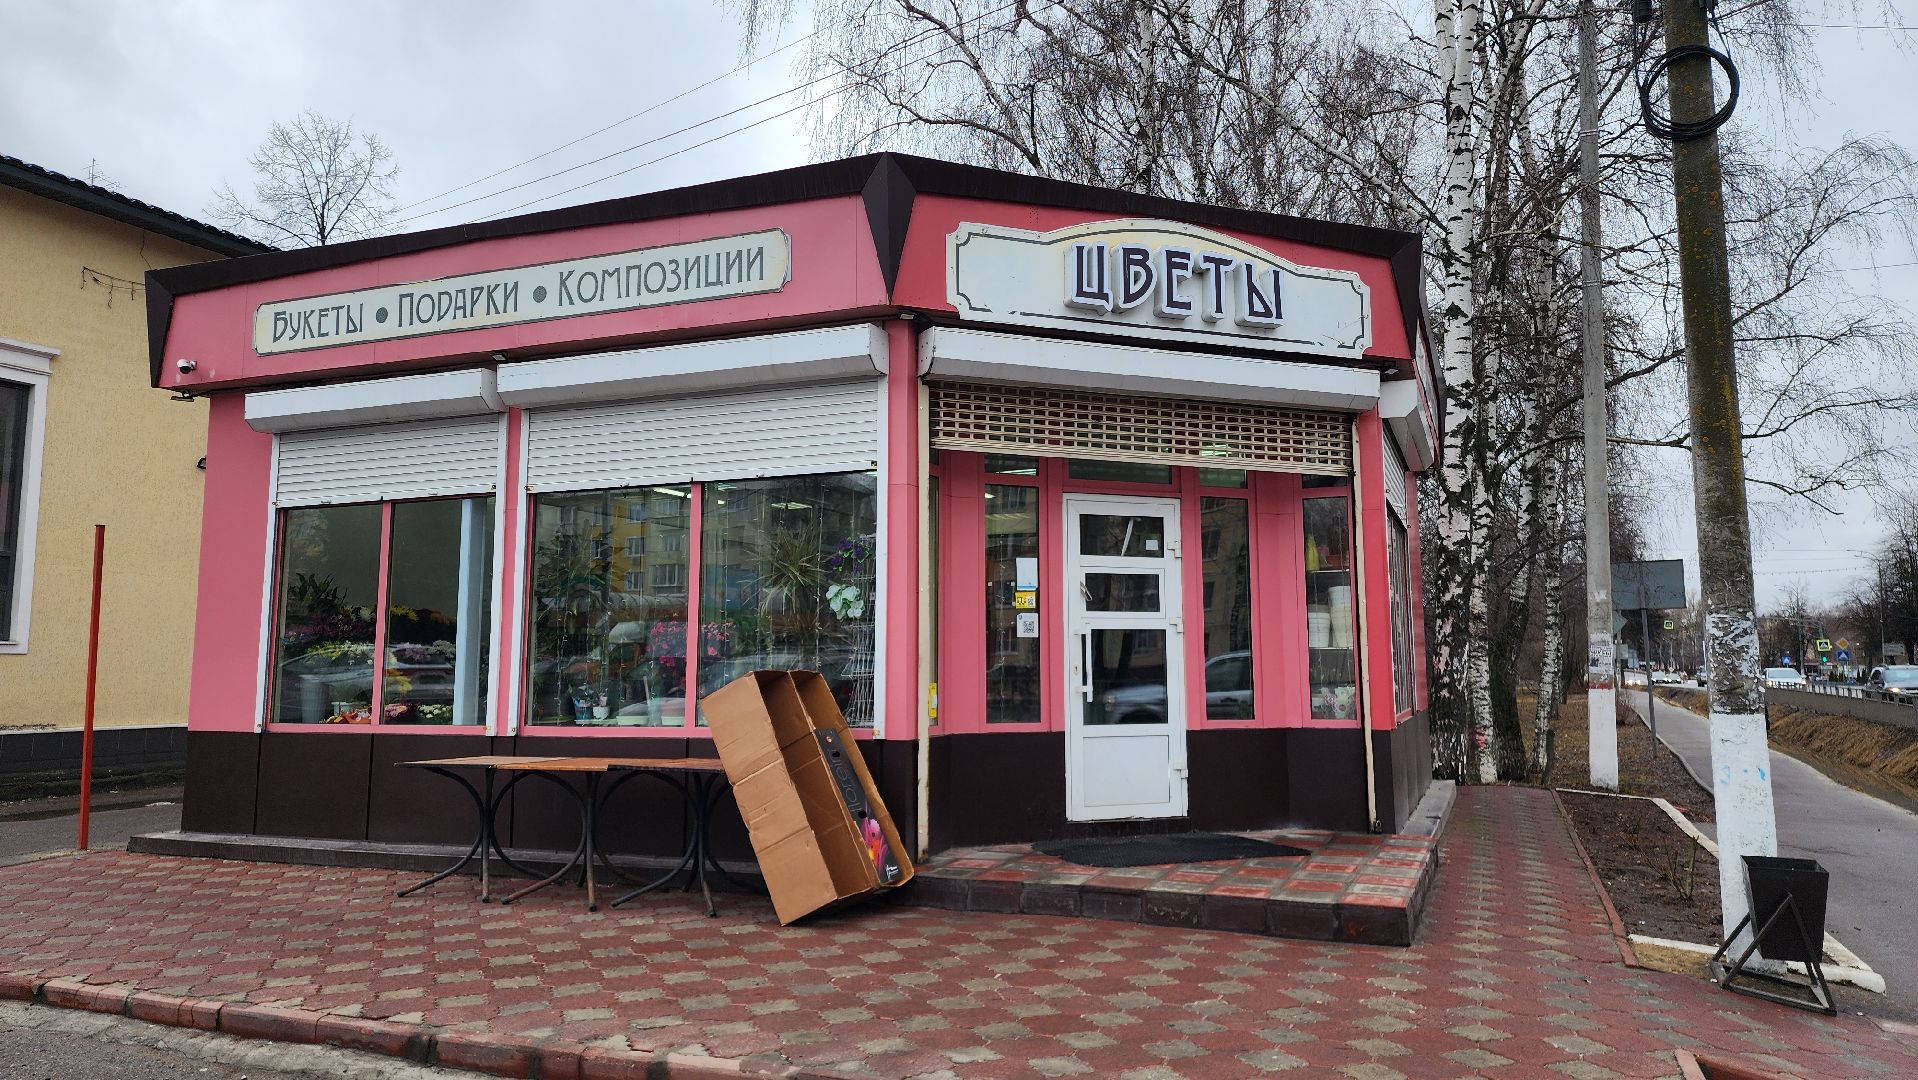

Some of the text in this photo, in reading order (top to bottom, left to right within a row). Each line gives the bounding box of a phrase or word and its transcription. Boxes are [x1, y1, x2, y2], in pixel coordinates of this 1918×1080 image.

[272, 246, 764, 343] БУКЕТЫ ПОДАРКИ КОМПОЗИЦИИ
[1073, 242, 1284, 324] ЦВЕТЫ
